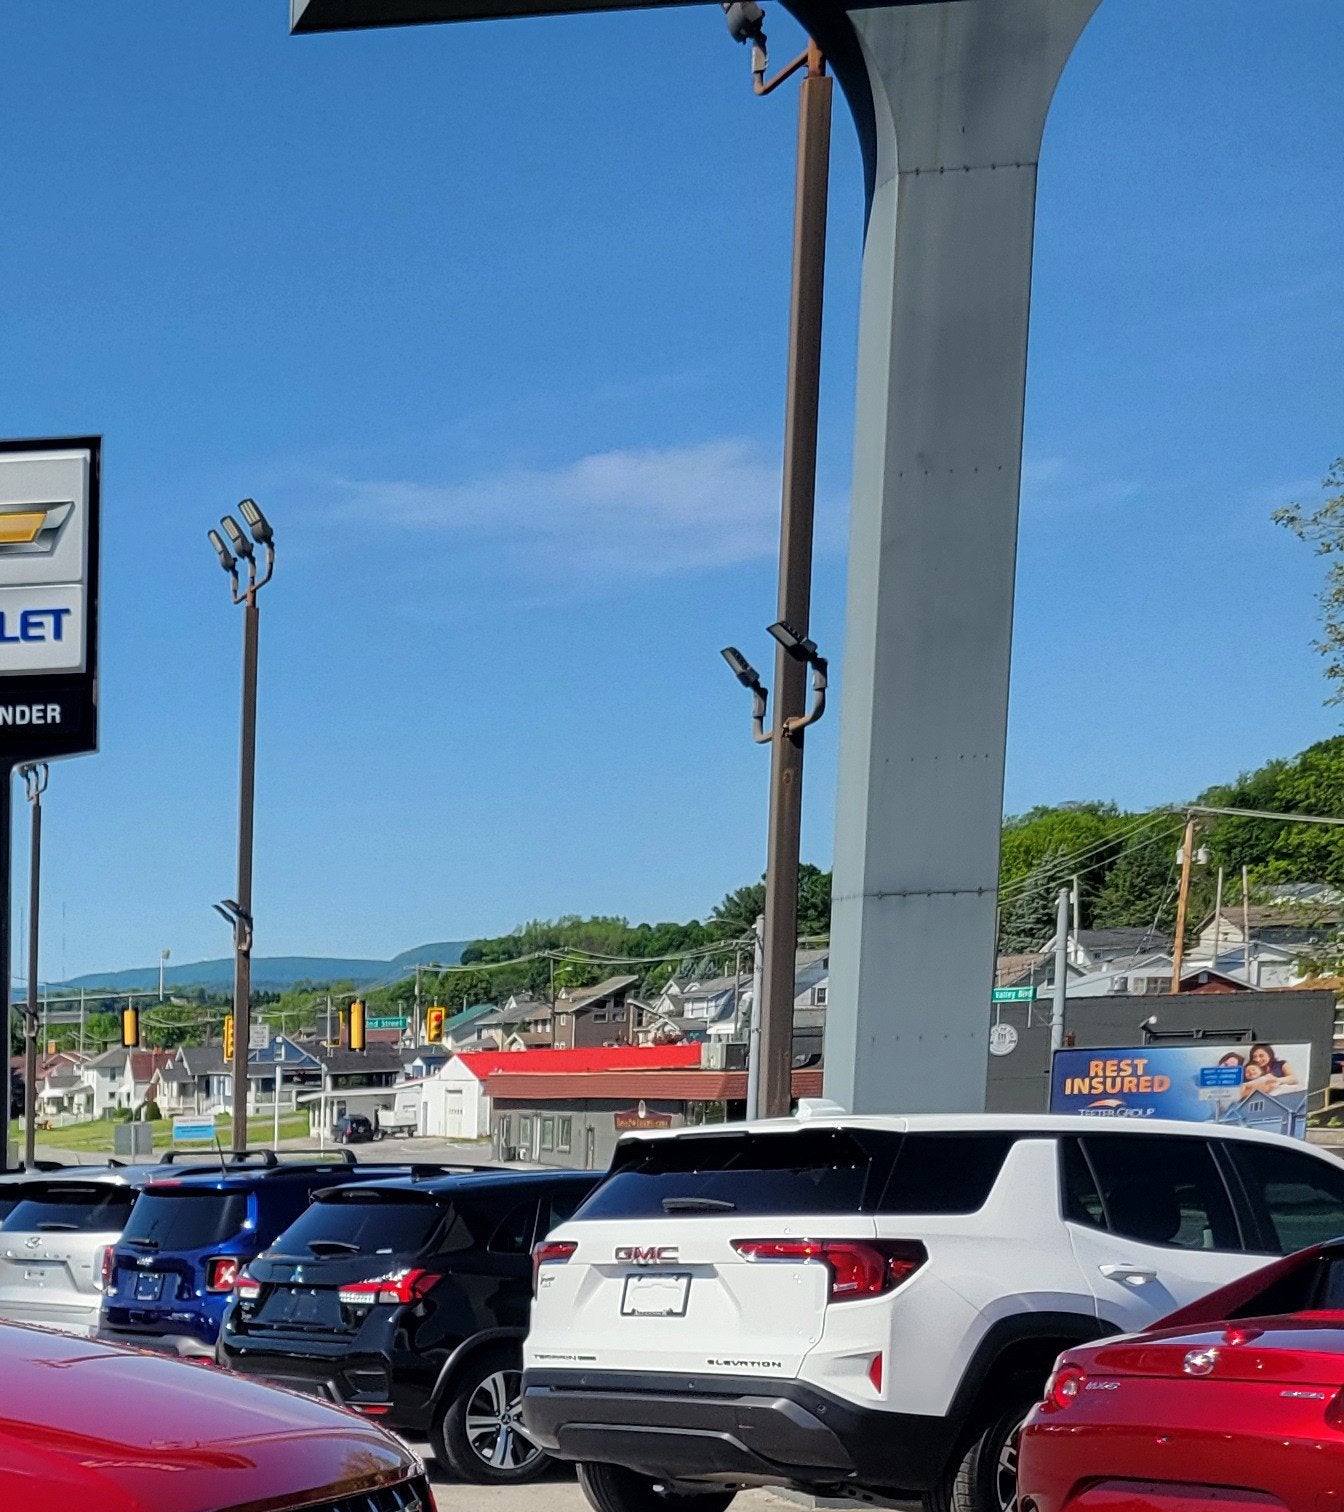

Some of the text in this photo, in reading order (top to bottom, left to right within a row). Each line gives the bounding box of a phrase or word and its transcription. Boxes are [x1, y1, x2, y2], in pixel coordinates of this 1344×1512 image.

[995, 991, 1016, 1000] Valley
[381, 1019, 403, 1028] Street
[1089, 1059, 1148, 1077] REST
[1064, 1075, 1171, 1096] INSURED
[614, 1246, 679, 1262] GMC
[707, 1358, 782, 1368] ELEVATION
